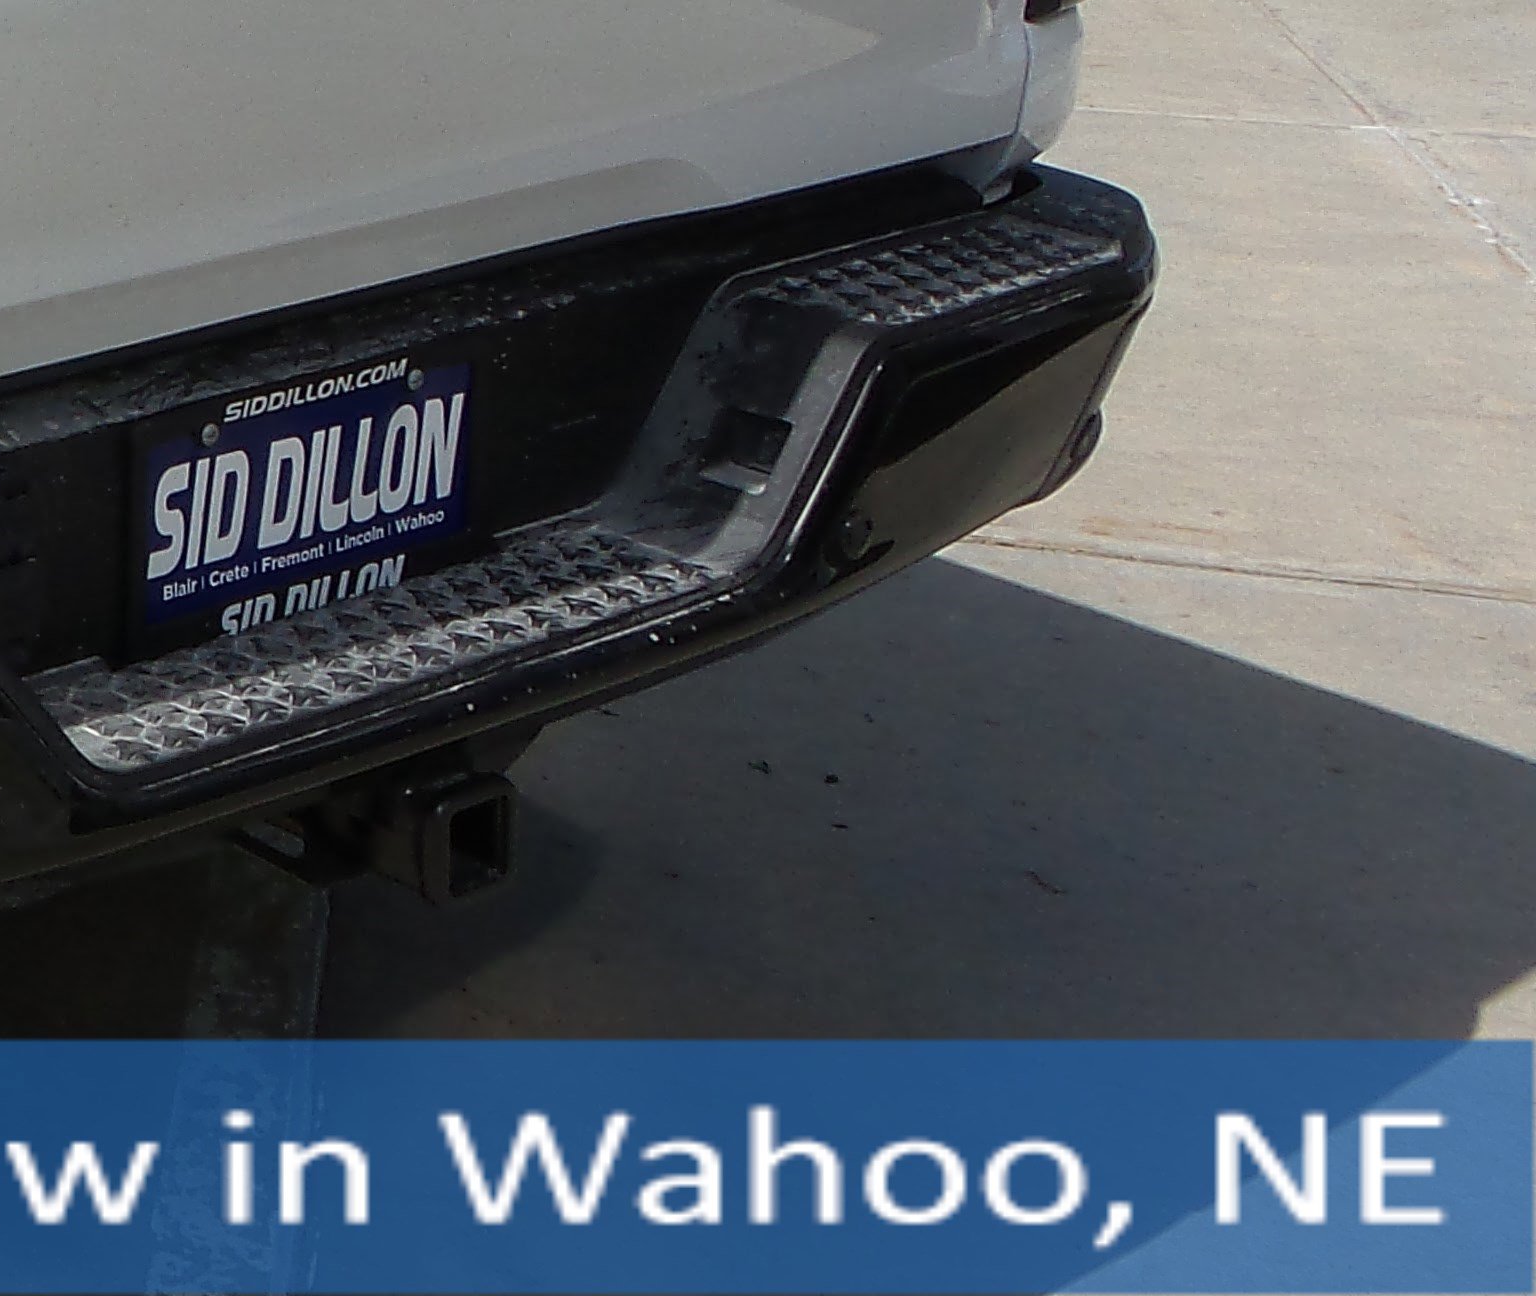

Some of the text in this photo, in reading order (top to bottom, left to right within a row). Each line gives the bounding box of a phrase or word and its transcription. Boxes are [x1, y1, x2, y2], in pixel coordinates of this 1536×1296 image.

[223, 357, 409, 423] SIDDILLON.COM
[146, 392, 466, 581] SID DILLON
[162, 509, 446, 602] Blair Crete Fremont Lincoln Wahoo
